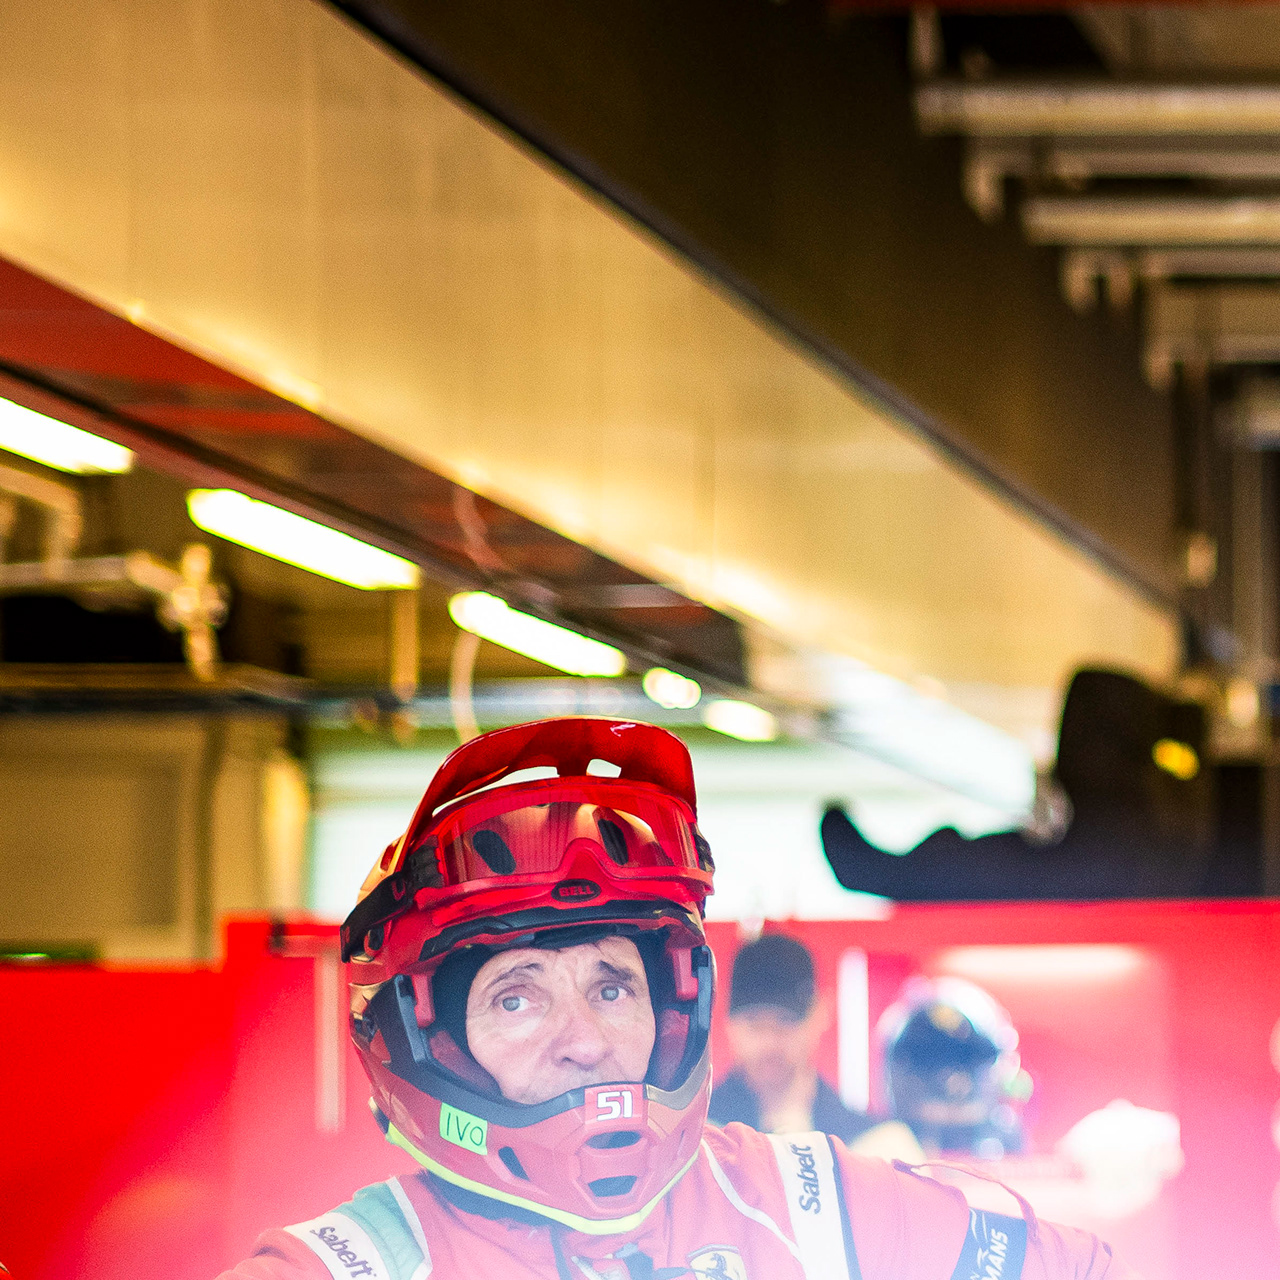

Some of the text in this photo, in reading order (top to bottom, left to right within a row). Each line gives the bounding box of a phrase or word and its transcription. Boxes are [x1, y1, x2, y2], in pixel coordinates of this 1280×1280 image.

[559, 885, 594, 896] BELL
[597, 1091, 633, 1121] 51
[447, 1112, 484, 1146] IVO
[791, 1138, 821, 1215] Sabelt
[309, 1226, 373, 1278] Sabelt
